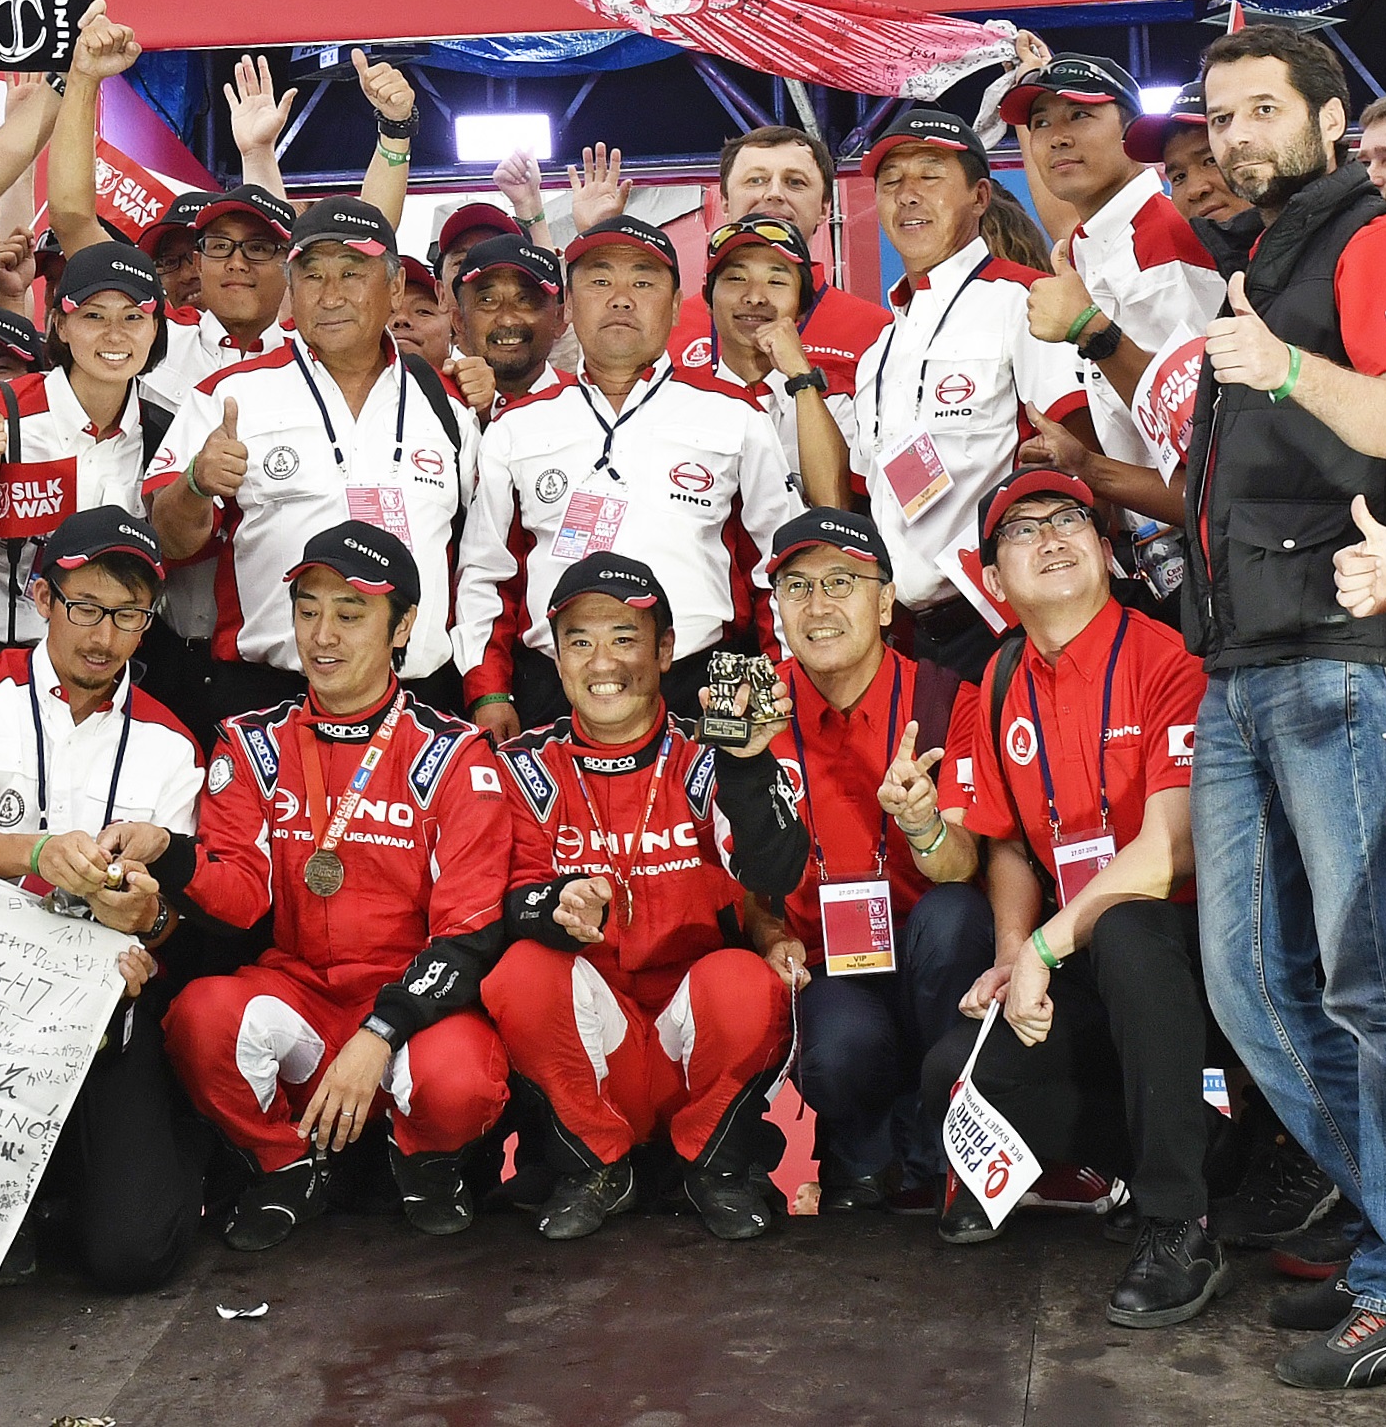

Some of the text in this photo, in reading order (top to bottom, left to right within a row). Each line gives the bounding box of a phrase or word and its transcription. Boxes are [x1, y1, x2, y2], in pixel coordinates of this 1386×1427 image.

[924, 120, 961, 134] HINO
[119, 177, 165, 220] SILK
[112, 194, 156, 229] WAY
[262, 200, 292, 221] HINO
[347, 215, 380, 230] HINO
[632, 229, 666, 246] HINO
[531, 252, 554, 272] HINO
[124, 265, 154, 283] HINO
[1, 323, 31, 342] HINO
[814, 346, 855, 360] HINO
[1160, 354, 1202, 404] SILK
[934, 408, 973, 419] HINO
[11, 477, 64, 500] SILK
[413, 475, 446, 489] HINO
[12, 494, 64, 519] WAY
[669, 492, 713, 508] HINO
[593, 528, 617, 538] WAY
[594, 520, 618, 531] SILK
[835, 524, 869, 542] HINO
[130, 528, 157, 550] HINO
[590, 535, 614, 544] RALLY
[358, 543, 390, 567] HINO
[613, 571, 650, 586] HINO
[316, 721, 370, 738] sparco
[246, 728, 278, 776] sparco
[415, 735, 453, 785] sparco
[582, 755, 637, 771] sparco
[514, 753, 548, 801] sparco
[343, 832, 415, 849] UGAWARA
[1070, 845, 1099, 857] 27.07.2018
[630, 857, 702, 876] SUGAWAR
[838, 887, 871, 896] 27.07.2018
[853, 955, 867, 963] VIP
[857, 961, 876, 969] Square
